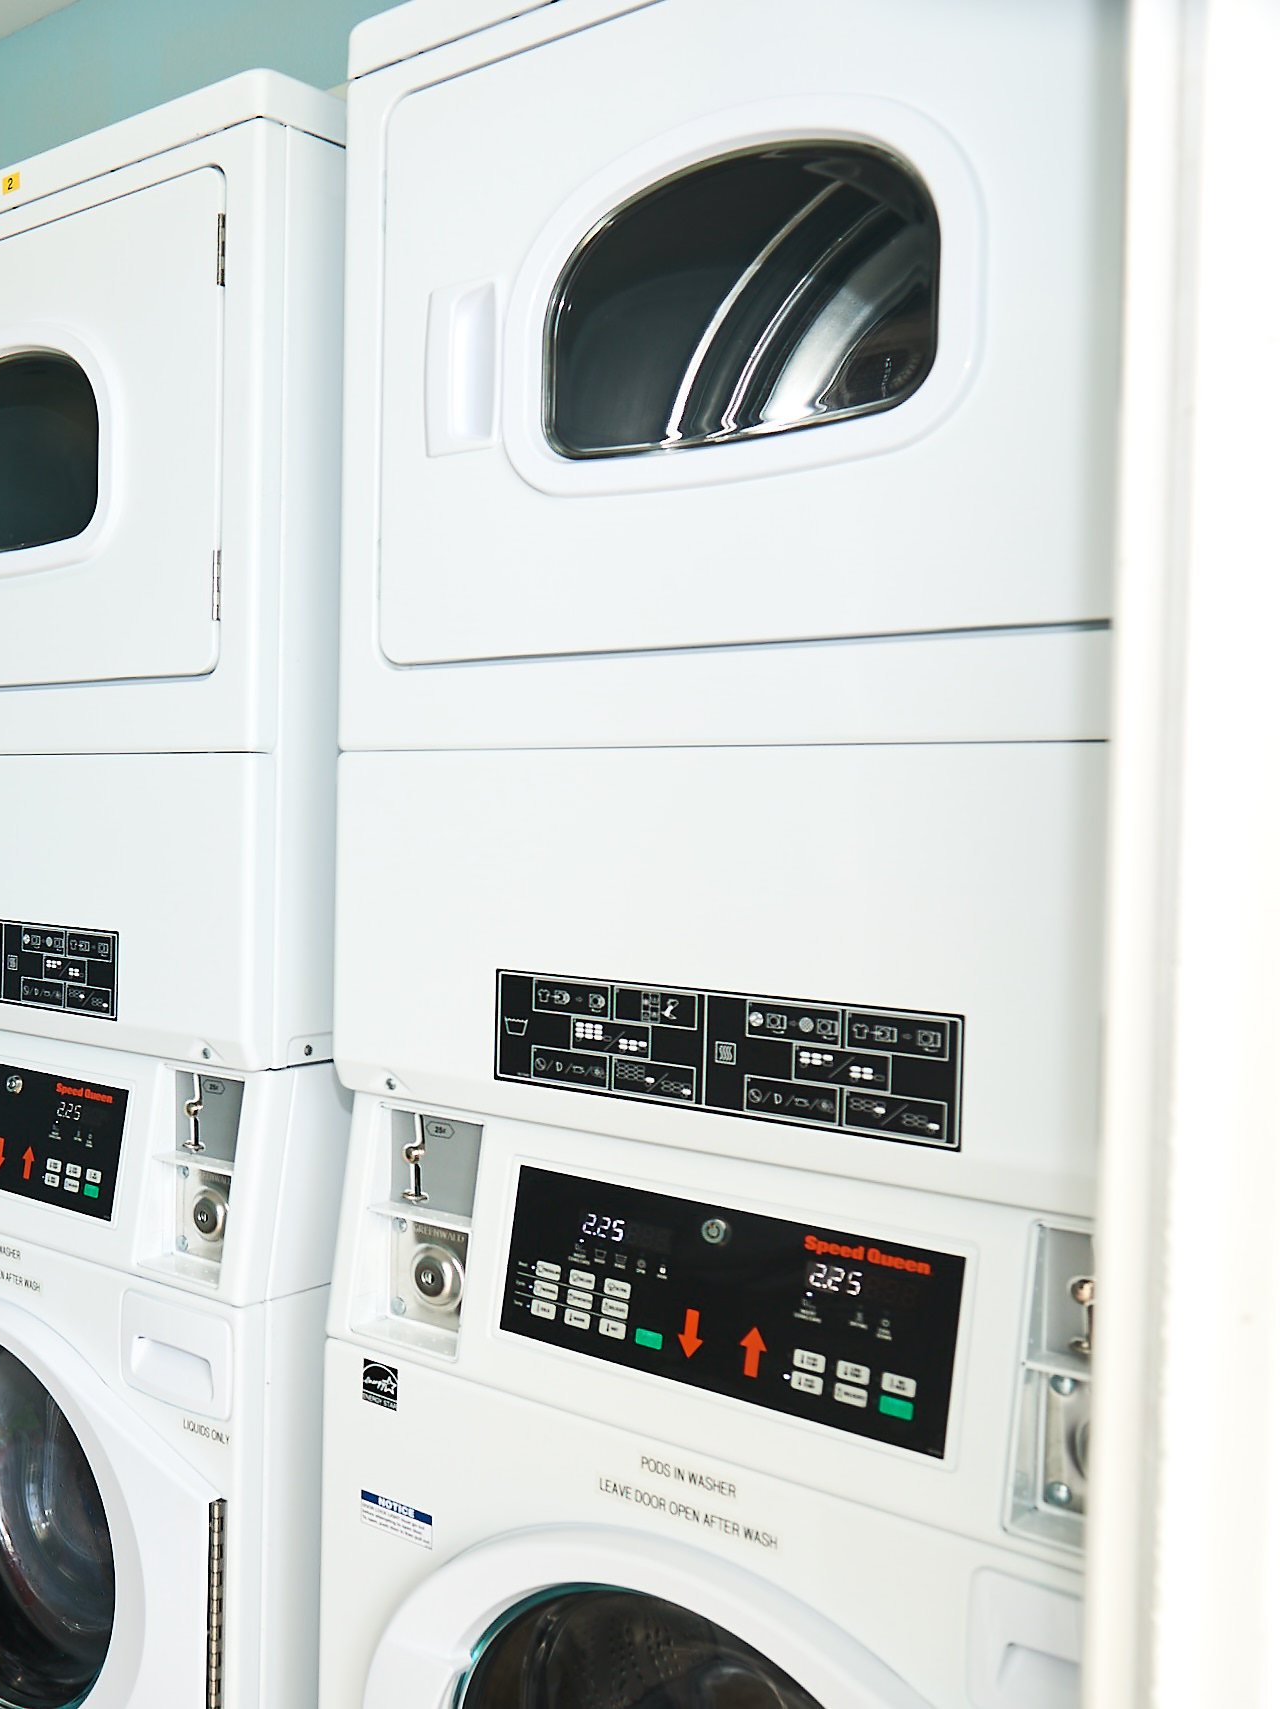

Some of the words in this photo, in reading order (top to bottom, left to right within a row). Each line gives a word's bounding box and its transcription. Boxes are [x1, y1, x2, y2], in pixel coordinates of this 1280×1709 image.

[8, 178, 13, 190] 2
[56, 1082, 84, 1098] Speed
[84, 1088, 114, 1104] Queen
[582, 1213, 626, 1242] 2.25
[804, 1234, 865, 1261] Speed
[867, 1248, 932, 1275] Queen
[809, 1263, 863, 1296] 2.25
[183, 1418, 210, 1438] LIQUIDS
[211, 1429, 230, 1445] ONLY
[641, 1456, 671, 1478] PODS
[674, 1467, 685, 1482] IN
[688, 1470, 737, 1498] WASHER
[378, 1496, 415, 1519] NOTICE
[599, 1477, 632, 1500] LEAVE
[634, 1489, 666, 1512] DOOR
[669, 1501, 700, 1523] OPEN
[703, 1513, 740, 1536] AFTER
[743, 1526, 778, 1549] WASH
